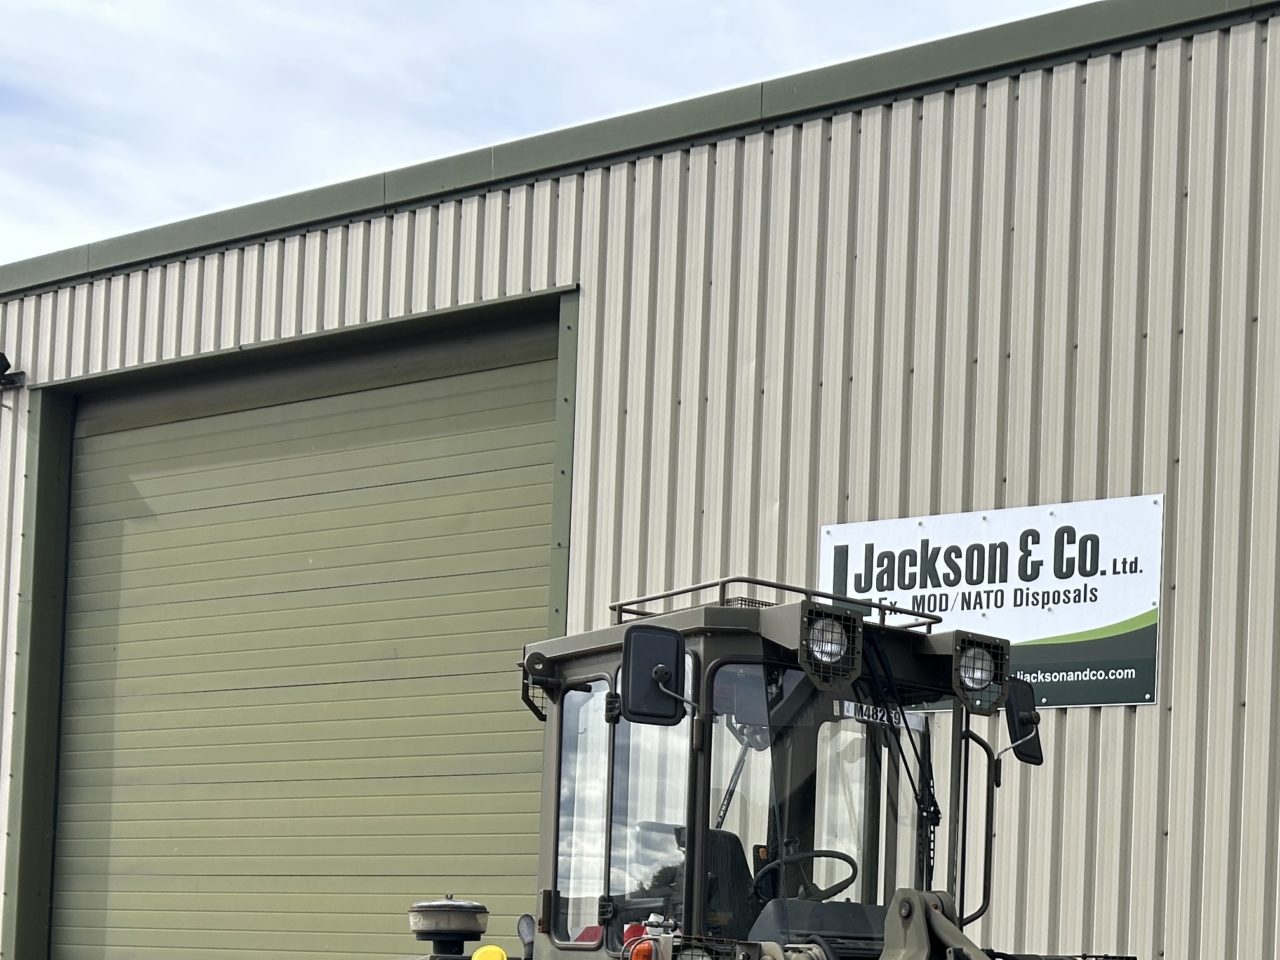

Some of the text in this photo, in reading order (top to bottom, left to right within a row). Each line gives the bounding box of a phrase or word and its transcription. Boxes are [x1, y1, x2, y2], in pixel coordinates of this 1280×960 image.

[1017, 528, 1044, 583] &
[1053, 525, 1107, 578] Co.
[1112, 556, 1144, 575] Ltd.
[911, 588, 1005, 614] MOD/NATO
[1013, 583, 1099, 610] Disposals
[854, 702, 901, 726] M4829
